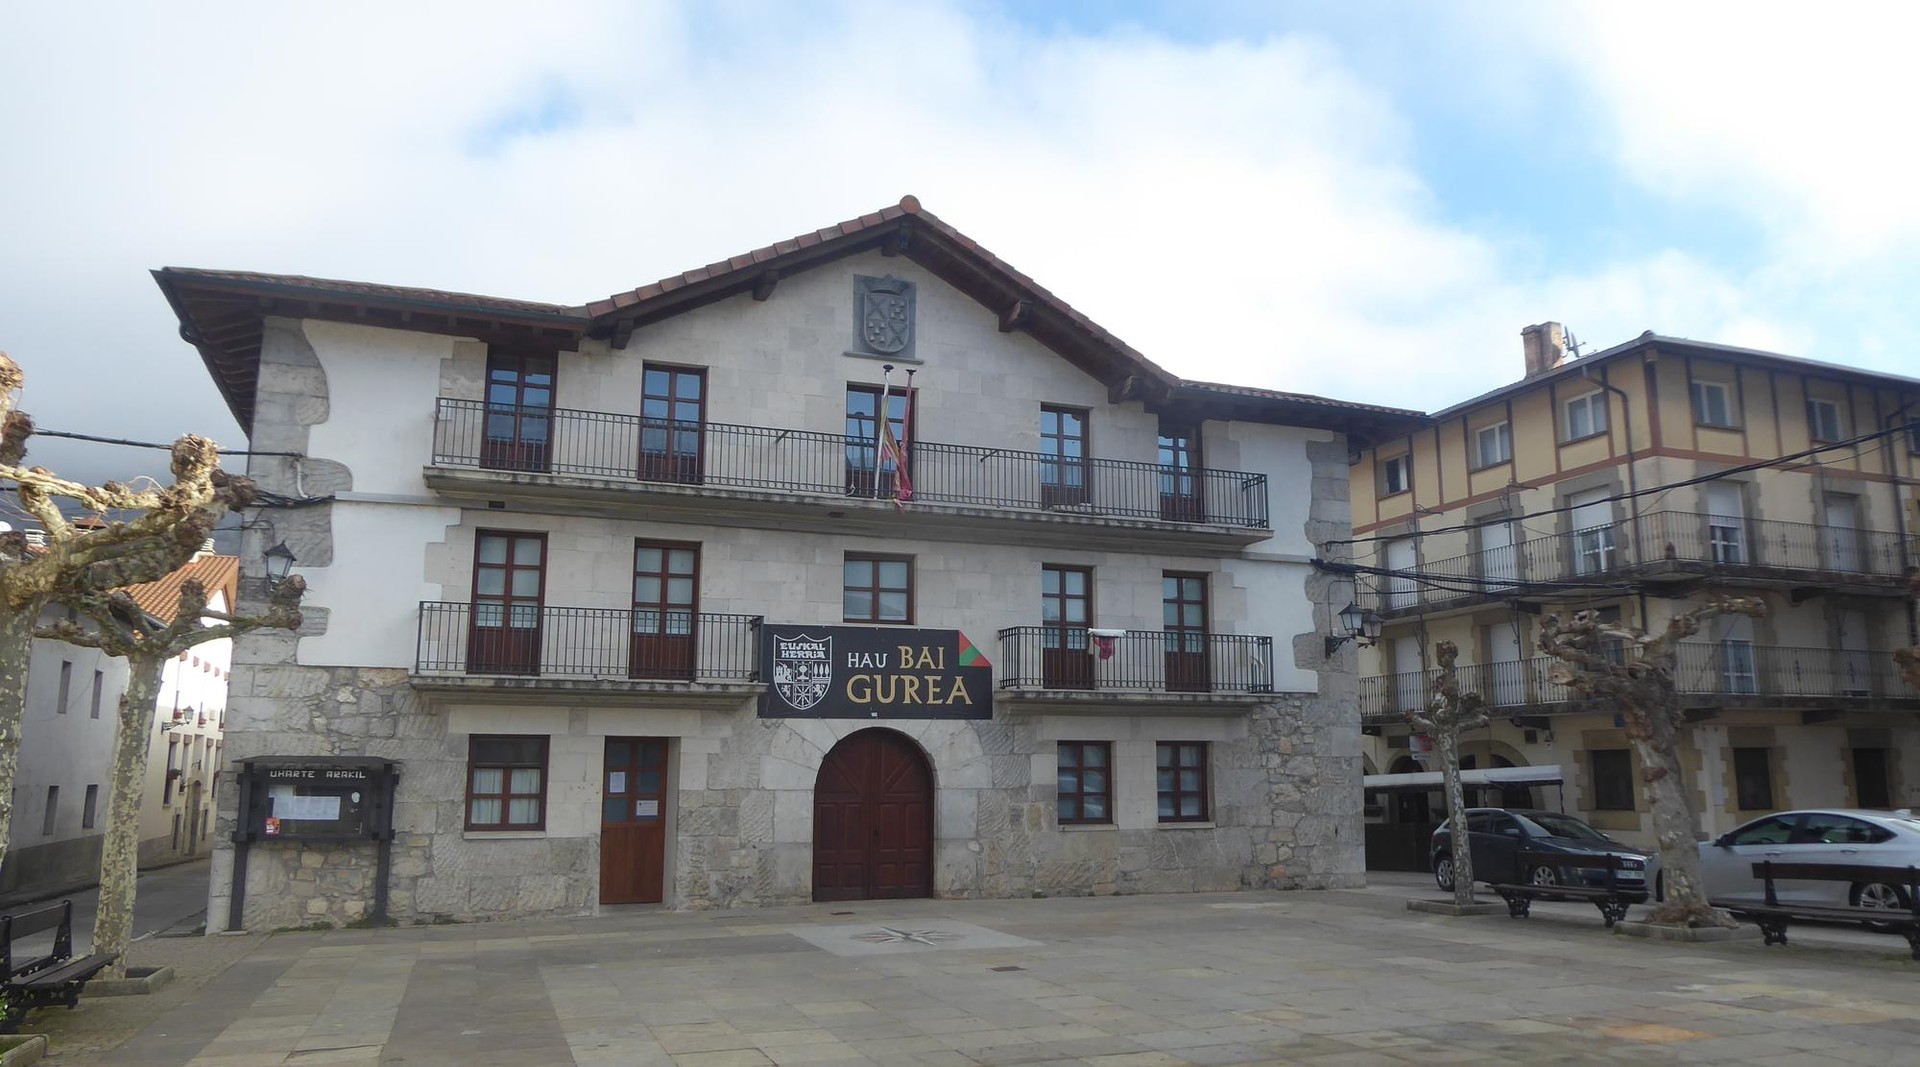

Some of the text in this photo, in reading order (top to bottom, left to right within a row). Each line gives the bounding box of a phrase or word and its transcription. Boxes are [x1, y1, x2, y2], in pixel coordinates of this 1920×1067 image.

[780, 642, 826, 650] EUSKAL
[847, 645, 945, 670] HAU BAI
[846, 674, 973, 705] GUREA
[270, 770, 366, 779] UHARTE ARAKIL
